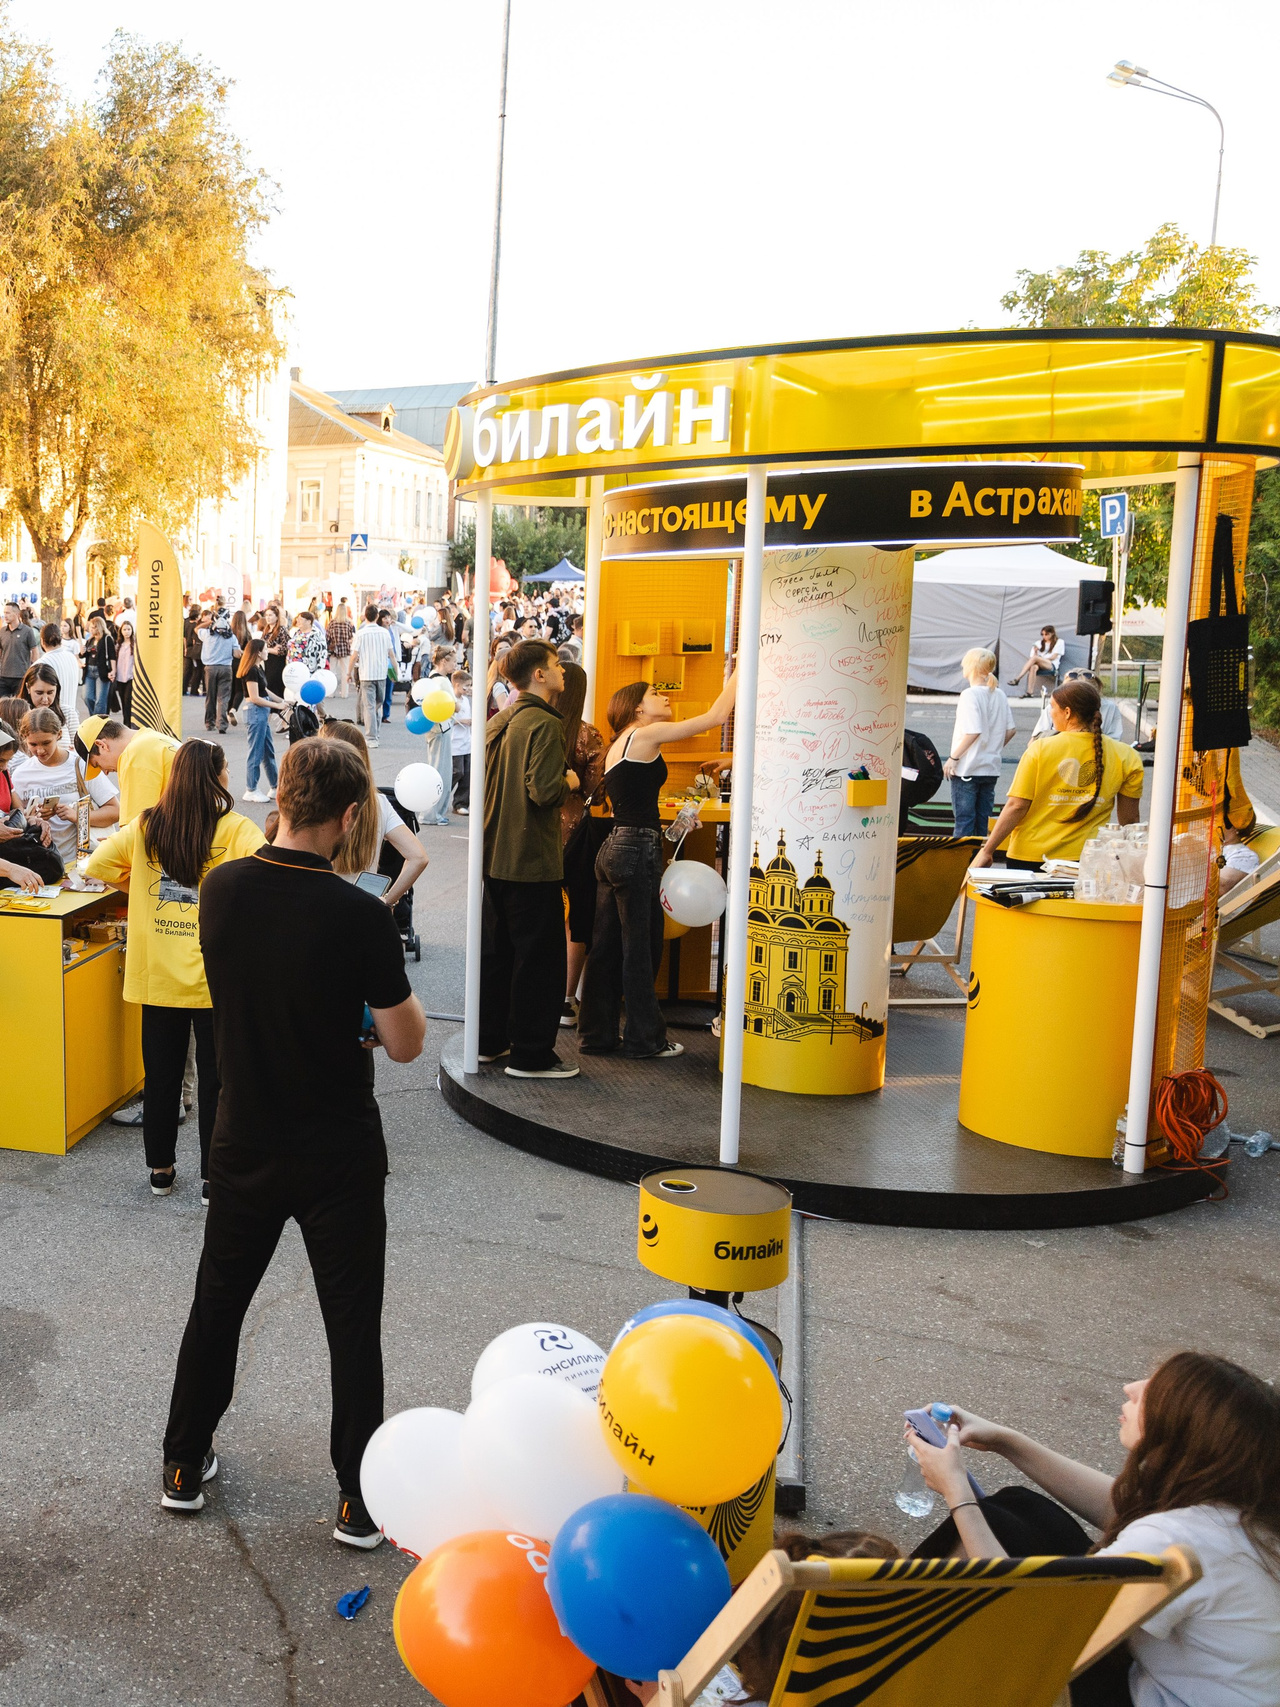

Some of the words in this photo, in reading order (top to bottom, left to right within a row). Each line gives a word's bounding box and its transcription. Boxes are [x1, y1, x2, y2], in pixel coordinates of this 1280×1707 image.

[473, 373, 731, 468] билайн
[910, 489, 932, 518] в
[603, 494, 827, 540] о-настоящему
[149, 559, 164, 639] билайн
[760, 633, 783, 648] ГМУ
[1070, 794, 1105, 803] любвь
[822, 831, 878, 842] ВАСИЛИСА
[154, 917, 198, 930] человек
[165, 929, 195, 938] Билайна
[714, 1238, 784, 1261] билайн
[538, 1355, 606, 1377] ОНСИЛИУМ
